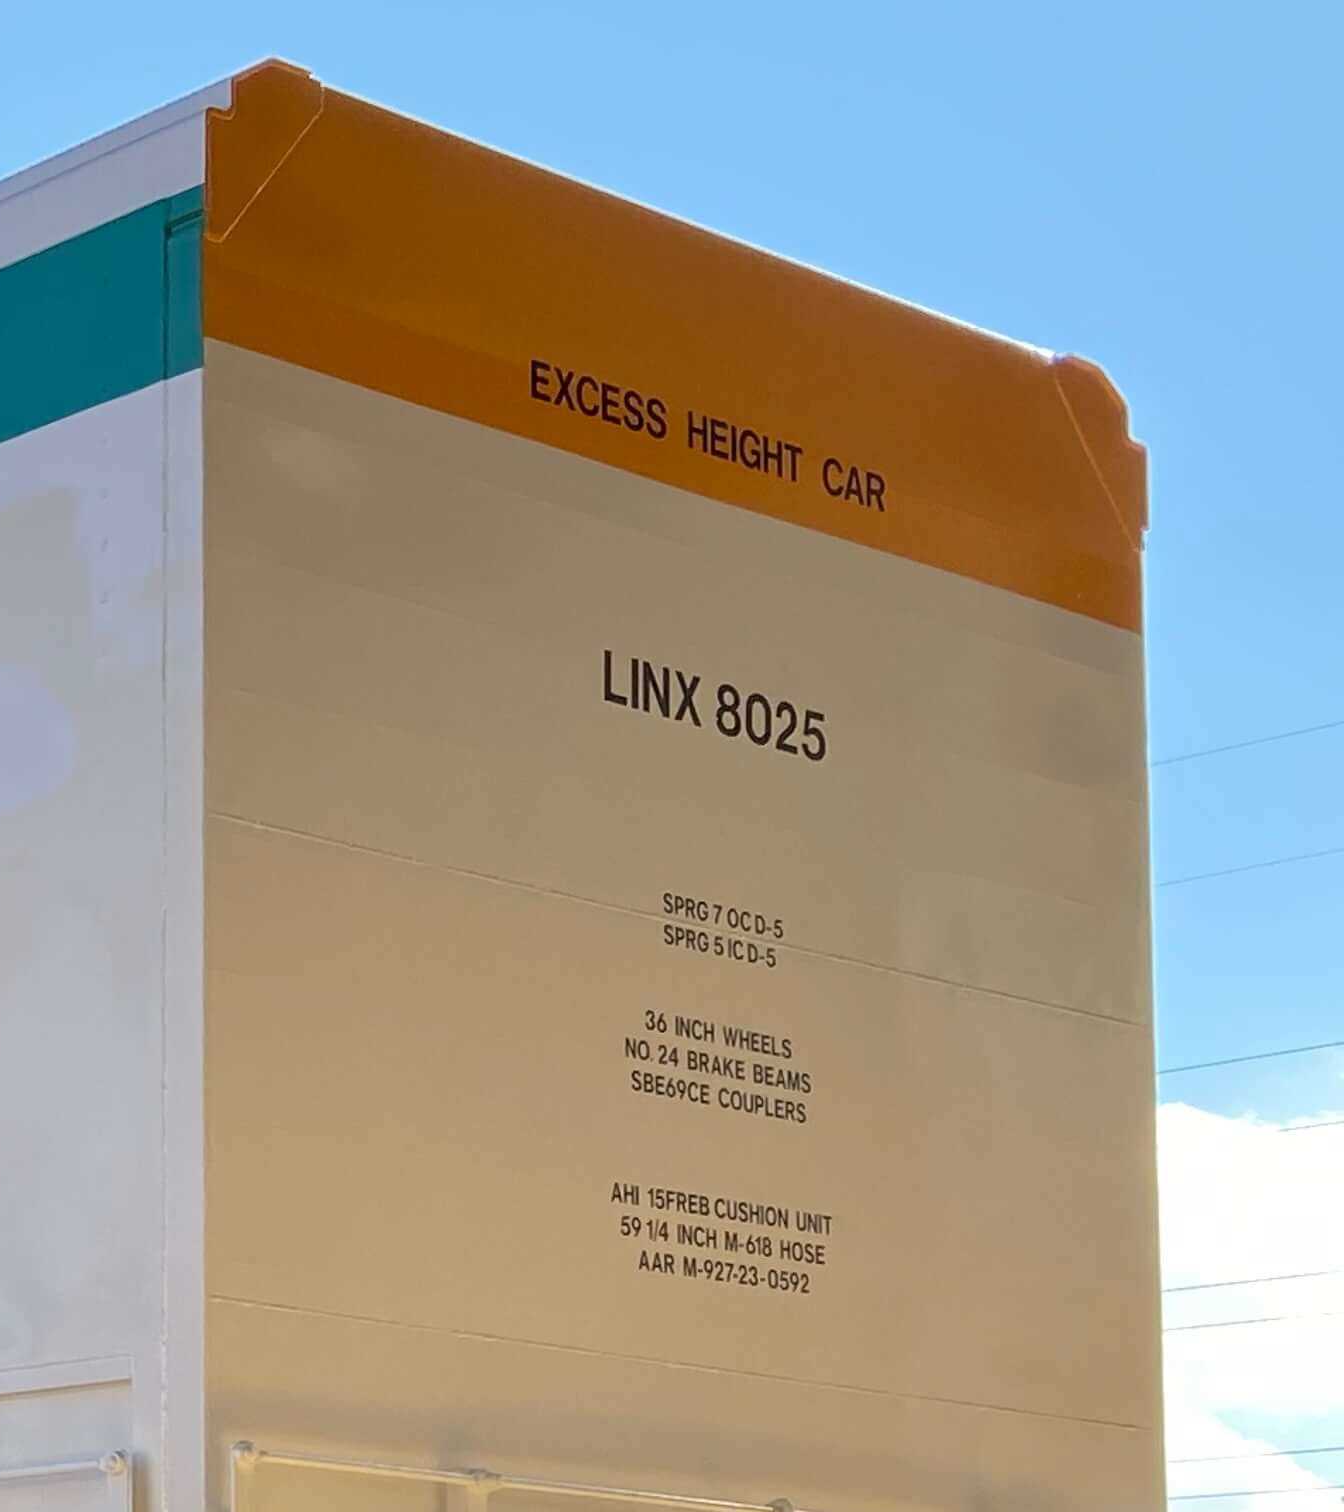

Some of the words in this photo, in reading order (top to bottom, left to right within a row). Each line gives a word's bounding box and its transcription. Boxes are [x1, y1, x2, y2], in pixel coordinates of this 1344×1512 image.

[530, 359, 667, 440] EXCESS
[687, 410, 803, 483] HEIGHT
[822, 457, 886, 512] CAR
[603, 649, 702, 728] LINX
[715, 683, 827, 761] 8025
[663, 893, 708, 921] SPRG
[713, 904, 722, 924] 7
[727, 908, 752, 932] OC
[755, 915, 784, 939] D-5
[663, 924, 709, 953] SPRG
[714, 936, 724, 956] 5
[728, 939, 744, 961] IC
[748, 943, 777, 968] D-5
[645, 1009, 667, 1033] 36
[675, 1015, 715, 1043] INCH
[722, 1025, 793, 1060] WHEELS
[625, 1037, 654, 1063] NO.
[658, 1045, 679, 1067] 24
[687, 1050, 746, 1081] BRAKE
[753, 1064, 812, 1094] BEAMS
[631, 1070, 711, 1105] SBE69CE
[718, 1087, 807, 1124] COUPLERS
[611, 1182, 640, 1205] AHI
[647, 1188, 710, 1216] 15FREB
[714, 1198, 789, 1229] CUSHION
[796, 1210, 832, 1235] UNIT
[620, 1216, 642, 1237] 59
[646, 1219, 669, 1242] 1/4
[677, 1224, 717, 1249] INCH
[724, 1231, 773, 1257] M-618
[780, 1239, 825, 1265] HOSE
[639, 1250, 675, 1274] AAR
[683, 1255, 810, 1293] M-927-23-0592
